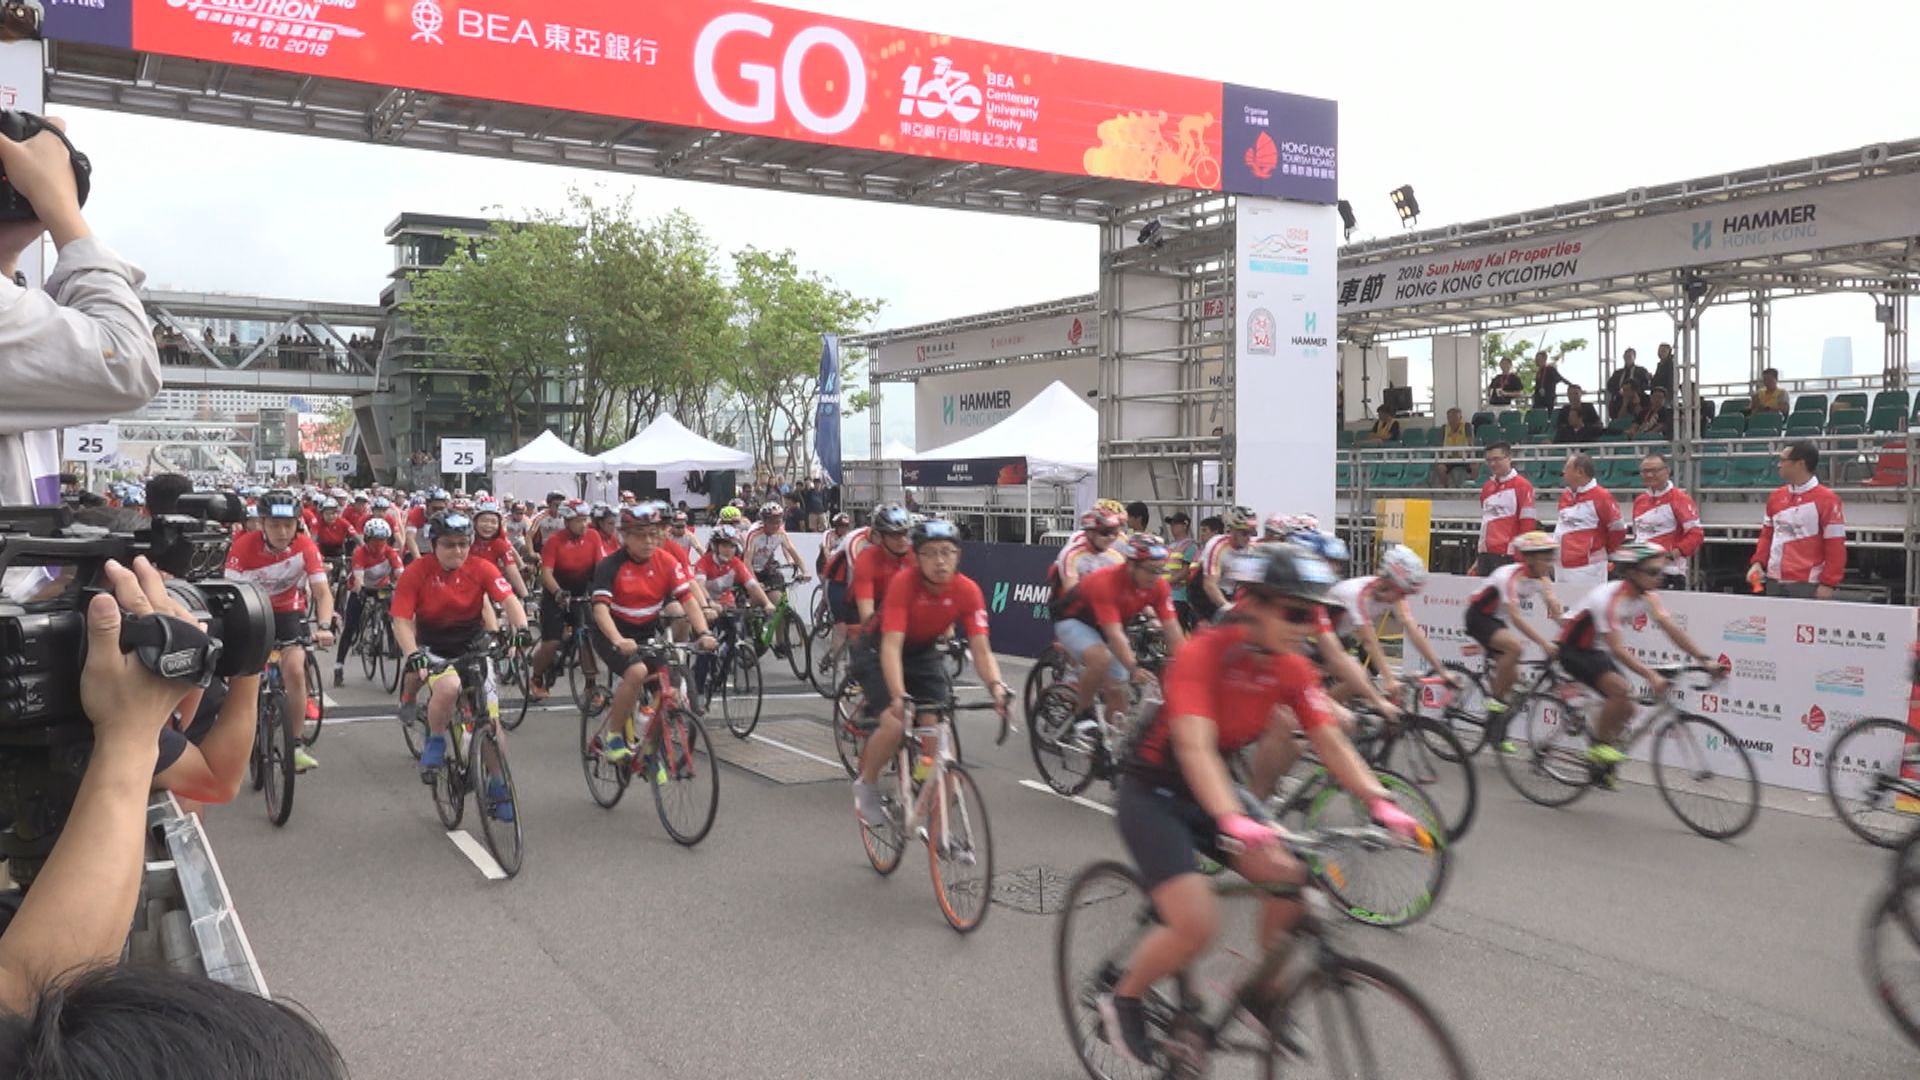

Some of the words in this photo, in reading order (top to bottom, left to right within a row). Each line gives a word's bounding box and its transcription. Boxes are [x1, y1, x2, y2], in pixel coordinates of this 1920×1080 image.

[232, 31, 253, 46] 14.
[258, 35, 279, 50] 10.
[284, 39, 328, 56] 2018
[457, 9, 539, 47] BEA
[543, 23, 658, 66] 東亞銀行
[693, 12, 867, 134] GO
[986, 72, 1015, 89] BEA
[985, 87, 1040, 108] Centenary
[986, 102, 1039, 122] University
[986, 114, 1023, 133] Trophy
[1281, 141, 1308, 155] HONG
[1309, 145, 1336, 159] KONG
[1282, 151, 1311, 165] TOURISM
[1311, 156, 1336, 168] BOARD
[1723, 204, 1816, 234] HAMMER
[1722, 232, 1766, 249] HONG
[1772, 224, 1817, 241] KONG
[1397, 264, 1424, 281] 2018
[1426, 263, 1449, 277] Sun
[1451, 256, 1484, 274] Hung
[1485, 250, 1506, 268] Kai
[1509, 242, 1582, 265] Properties
[1337, 272, 1386, 307] 車節
[1395, 282, 1437, 300] HONG
[1440, 274, 1483, 295] KONG
[1487, 259, 1578, 288] CYCLOTHON
[1291, 335, 1328, 347] HAMMER
[959, 389, 1012, 411] HAMMER
[78, 437, 103, 453] 25
[335, 461, 350, 472] 50
[453, 451, 474, 465] 25
[1723, 736, 1774, 753] HAMMER
